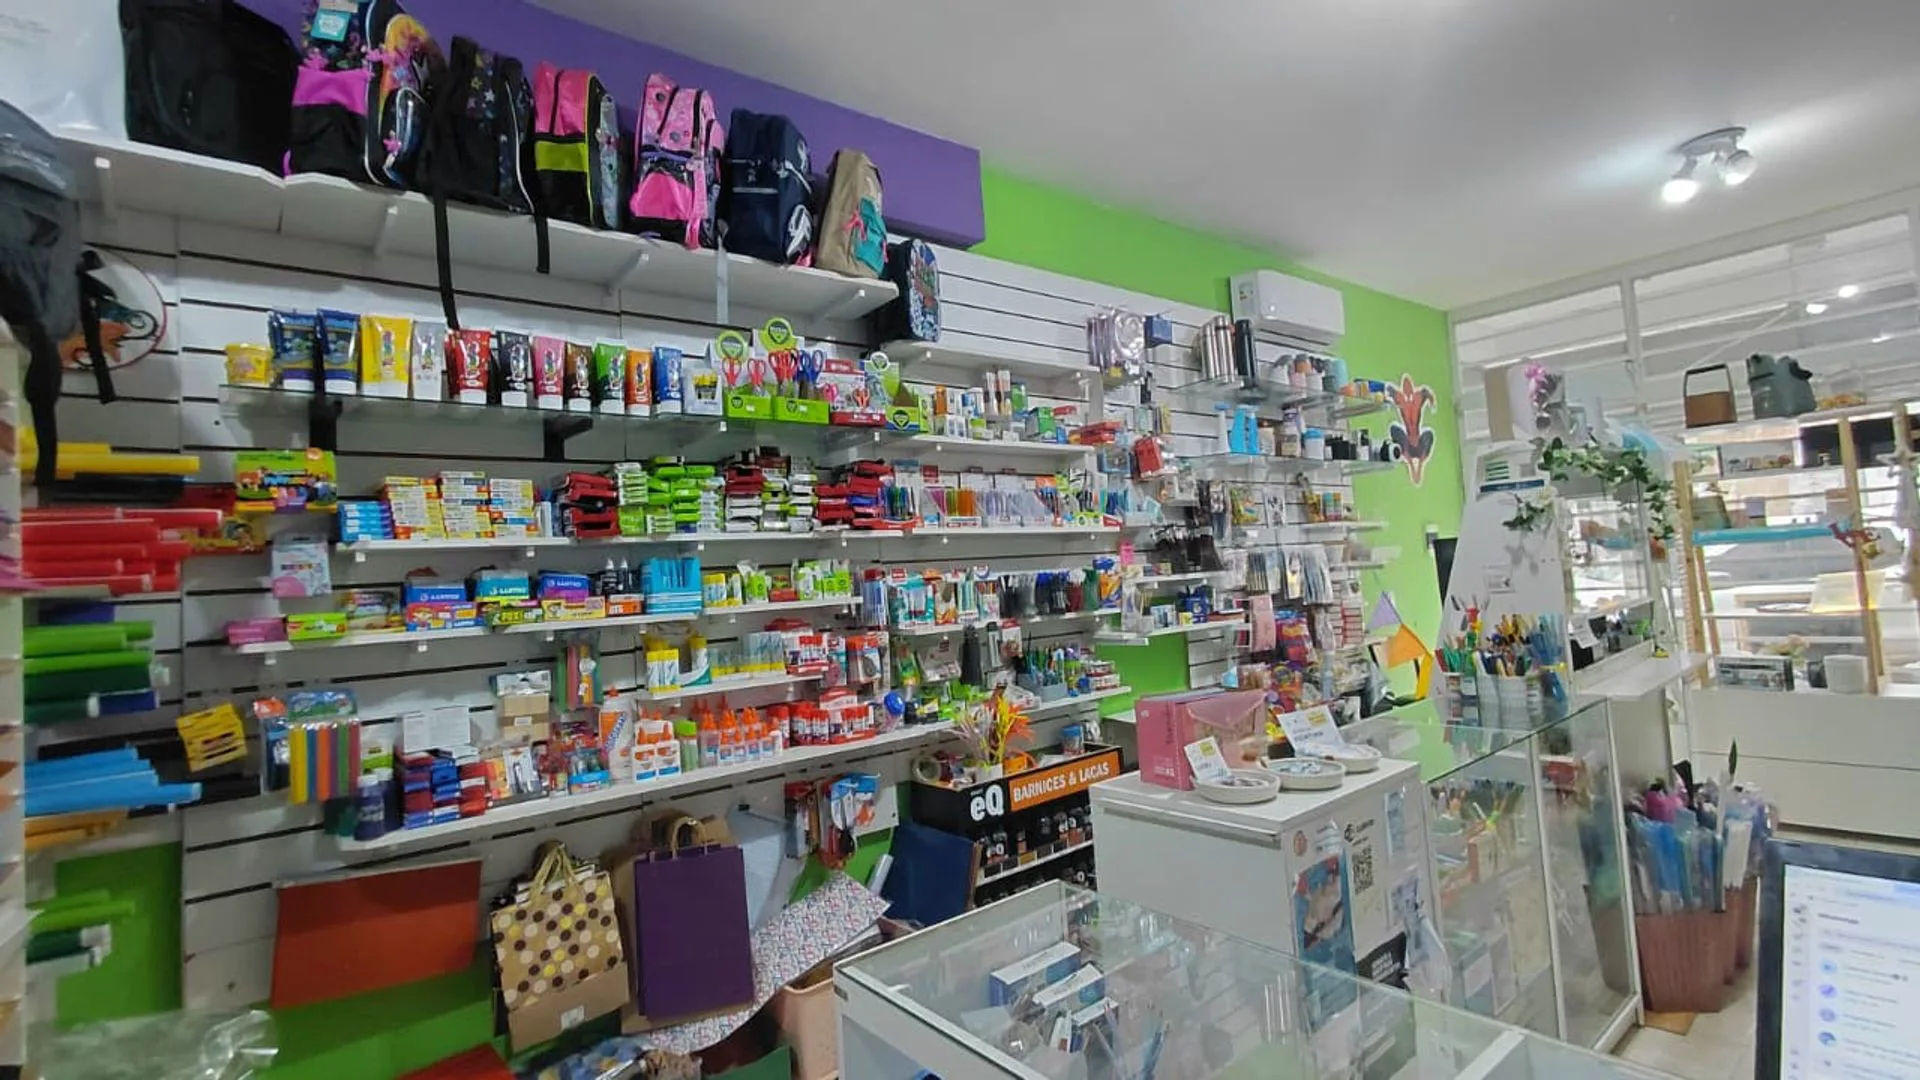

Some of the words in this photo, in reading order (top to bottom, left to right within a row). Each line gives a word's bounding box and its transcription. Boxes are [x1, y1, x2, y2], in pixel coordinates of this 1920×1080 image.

[1013, 775, 1066, 802] BARNICES
[1068, 773, 1077, 785] &
[1079, 762, 1110, 783] LACAS
[970, 784, 1004, 821] eQ
